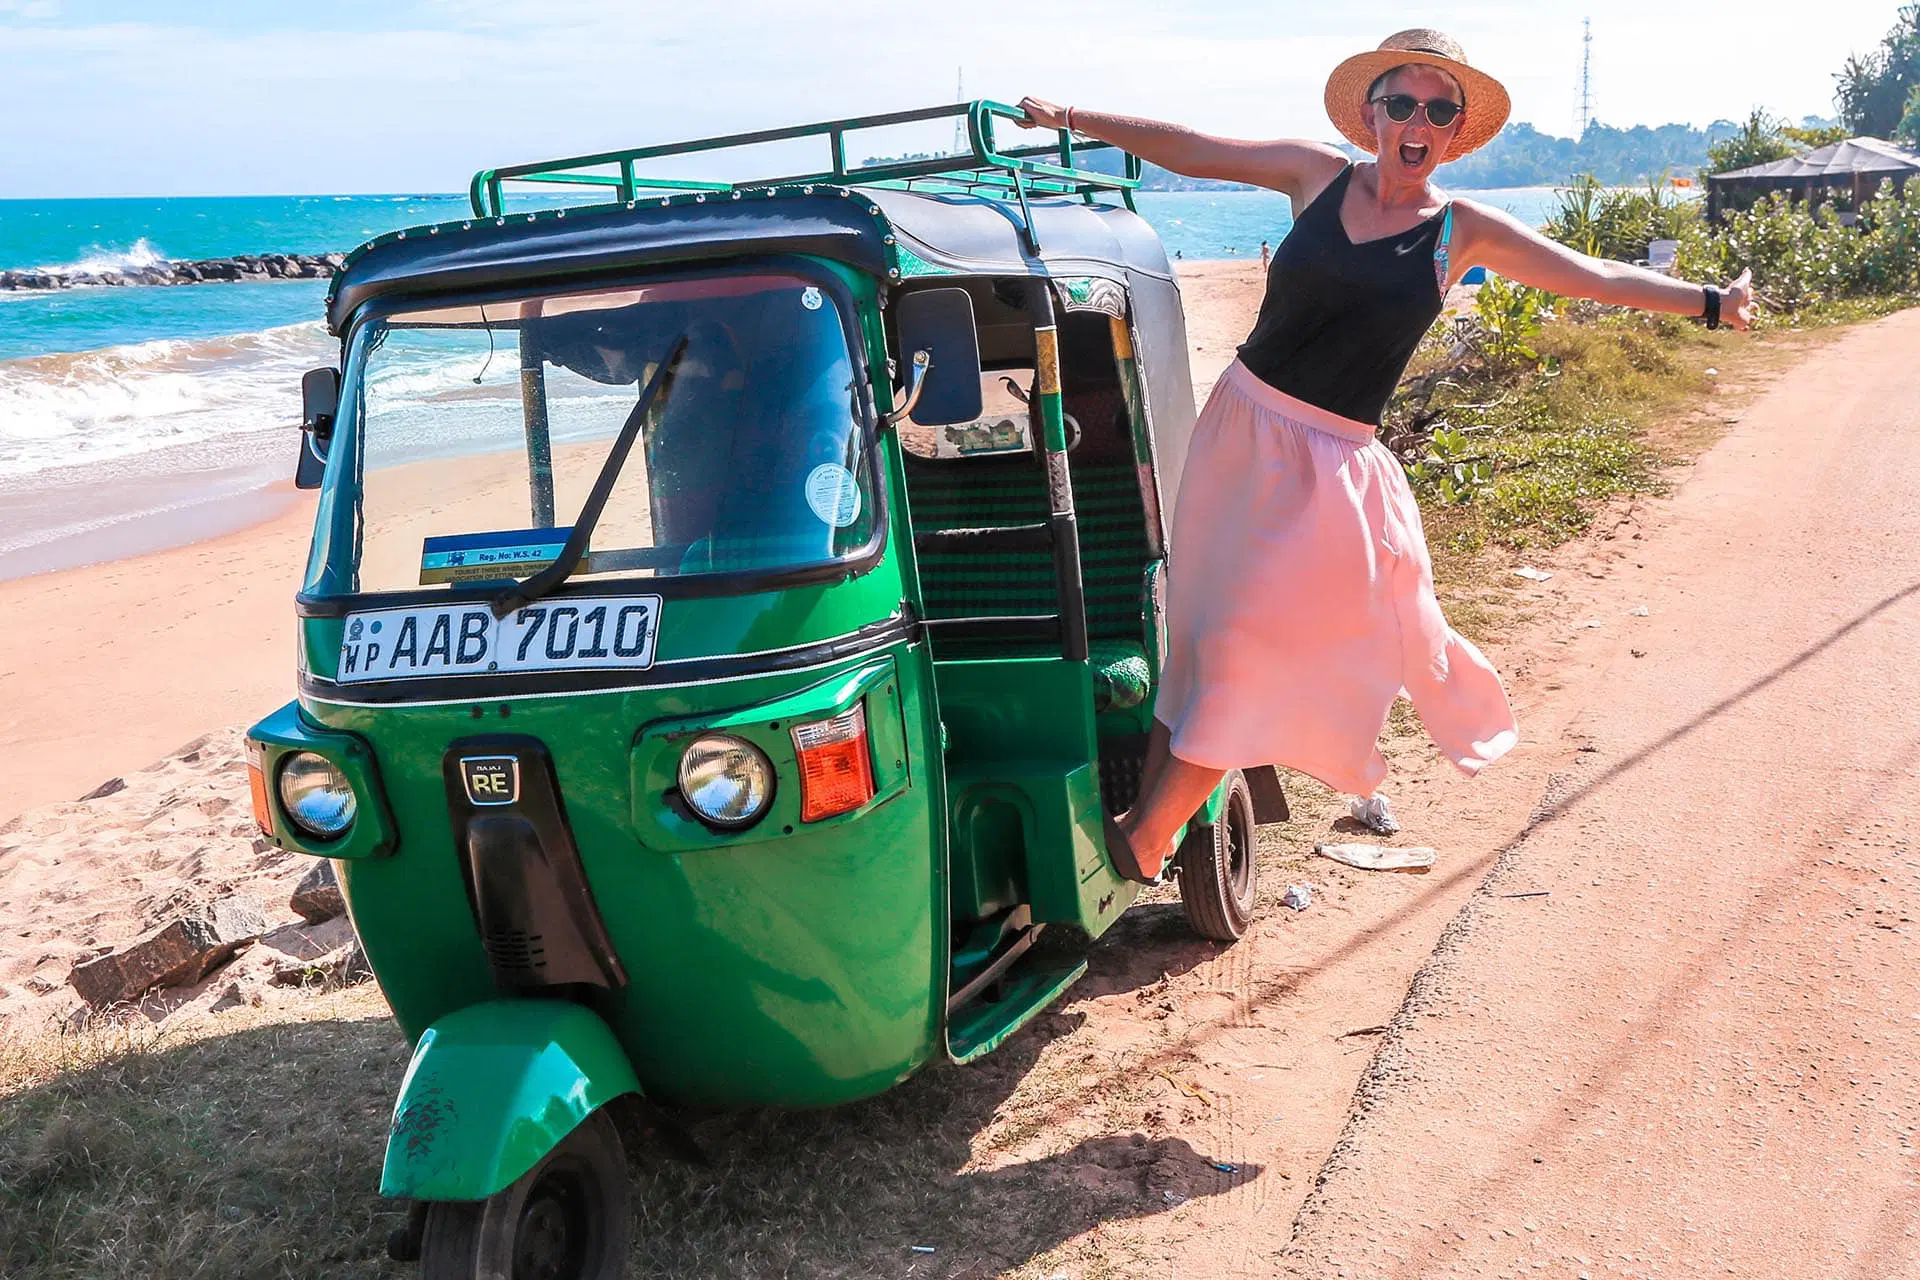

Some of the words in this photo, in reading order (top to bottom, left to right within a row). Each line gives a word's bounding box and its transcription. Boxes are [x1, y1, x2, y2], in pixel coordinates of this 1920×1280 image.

[479, 553, 497, 562] Reg.
[498, 551, 512, 560] No:
[388, 611, 491, 669] AAB
[515, 604, 650, 662] 7010
[472, 773, 509, 795] RE
